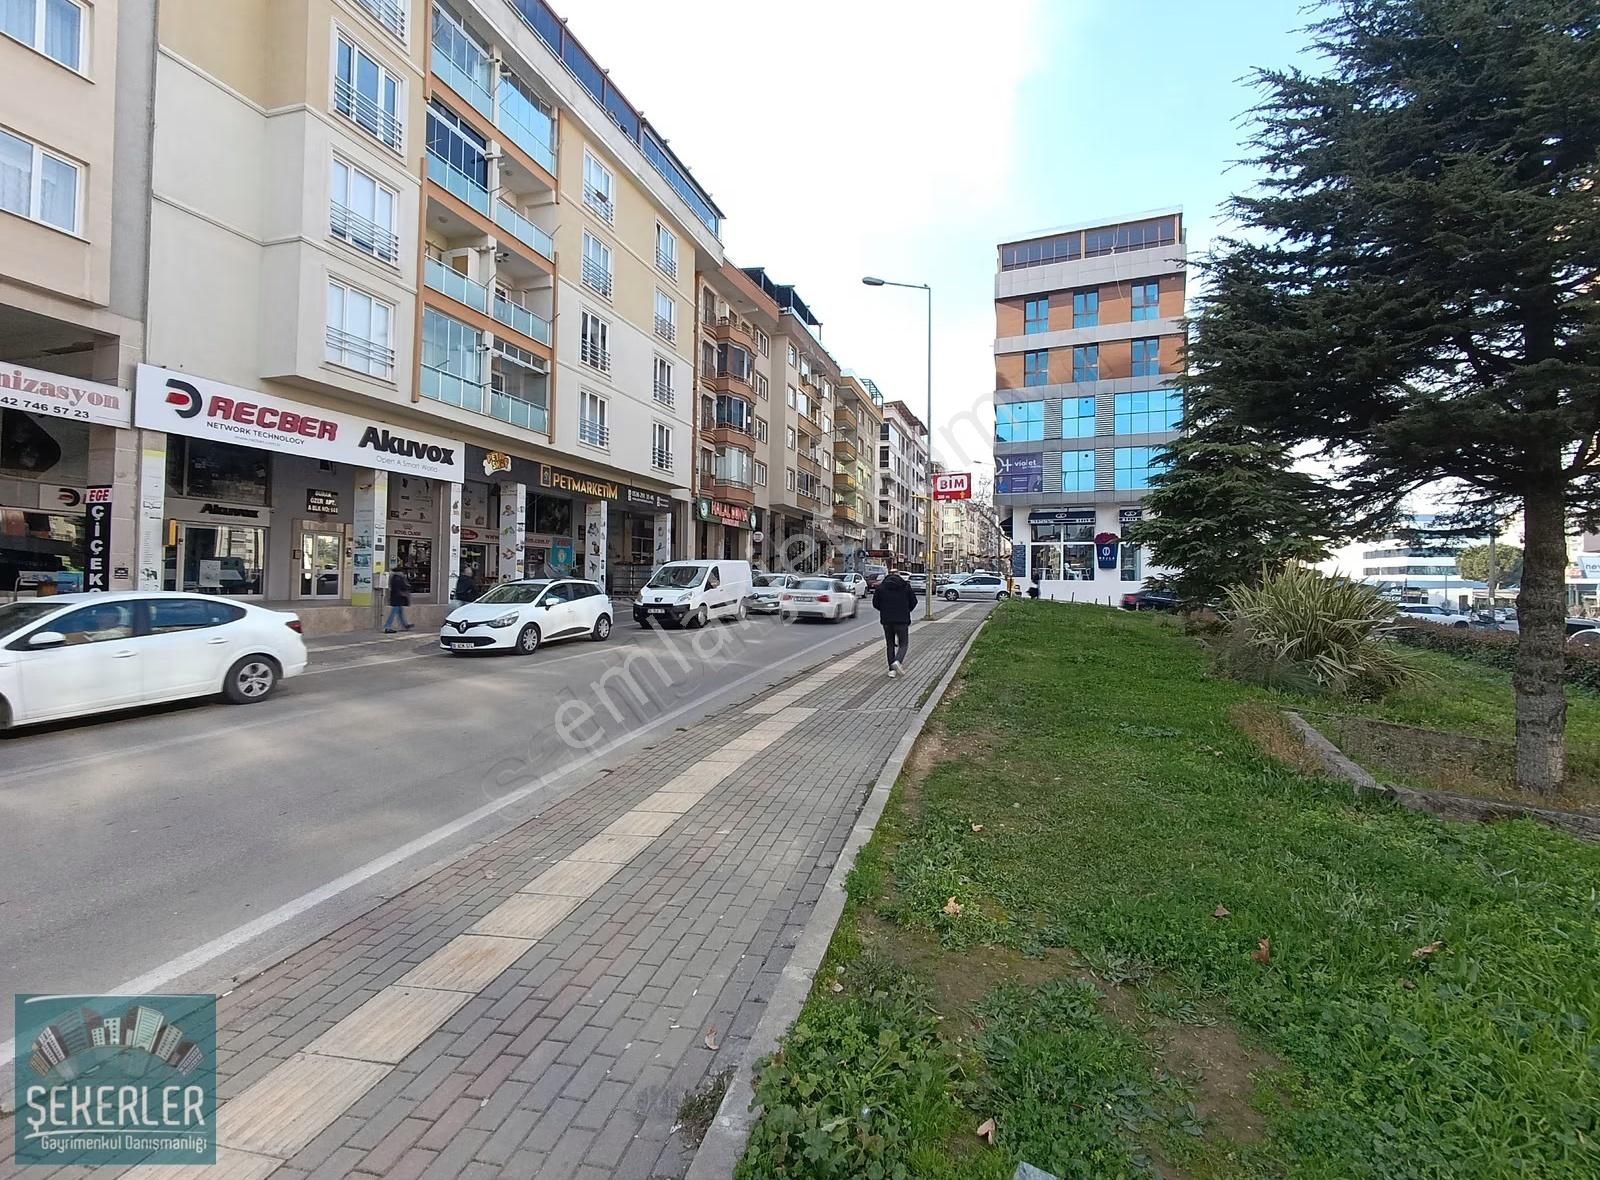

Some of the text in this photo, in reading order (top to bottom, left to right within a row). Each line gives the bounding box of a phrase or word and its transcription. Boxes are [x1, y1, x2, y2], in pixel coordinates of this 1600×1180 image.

[23, 400, 48, 411] 746
[53, 406, 69, 415] 57
[74, 410, 89, 418] 23
[207, 395, 338, 442] RECBER
[206, 421, 305, 445] NETWORK TECHNOLOGY
[358, 426, 455, 465] Akuvox
[376, 455, 395, 465] Open
[403, 461, 420, 470] Smart
[89, 489, 109, 502] EGE
